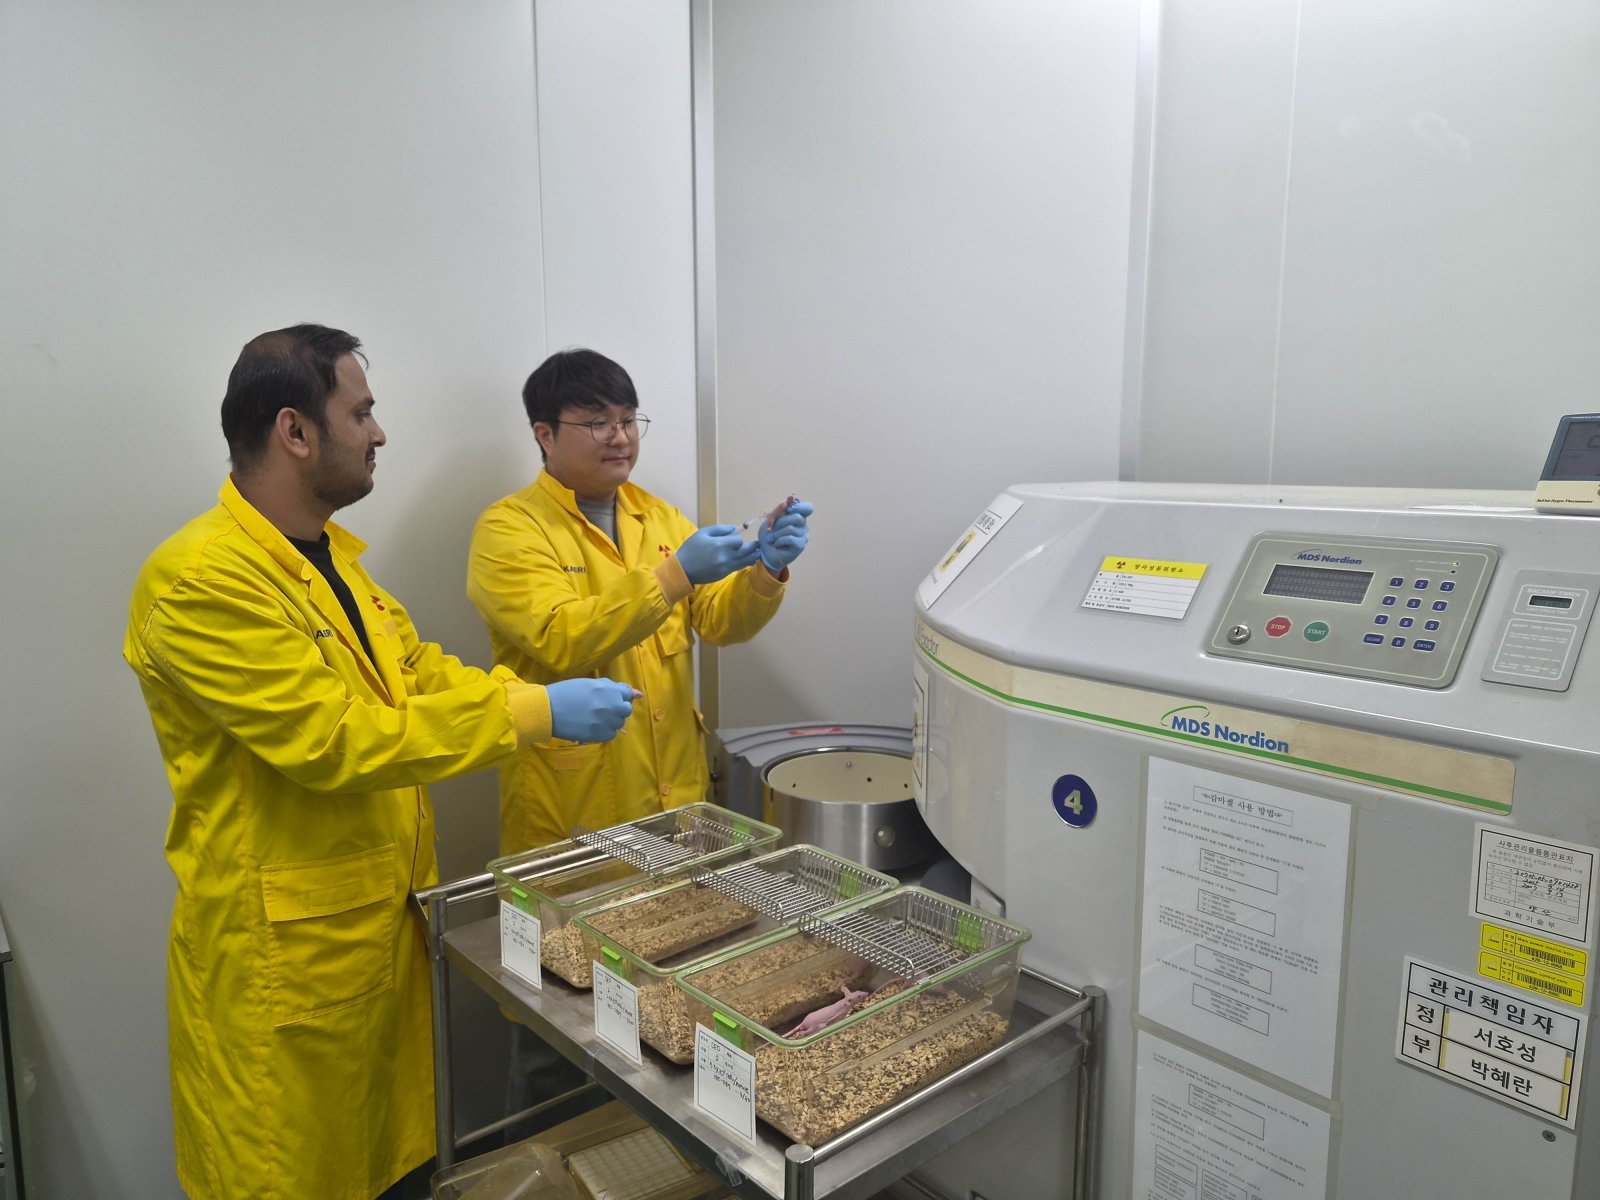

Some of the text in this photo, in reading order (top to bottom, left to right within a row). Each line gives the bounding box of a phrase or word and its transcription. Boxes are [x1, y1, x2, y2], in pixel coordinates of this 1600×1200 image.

[1297, 553, 1362, 565] MDS Nordion
[1172, 716, 1289, 753] MDS Nordion
[1064, 790, 1083, 815] 4
[1238, 802, 1254, 812] 사용
[1258, 807, 1274, 818] 방법
[1429, 978, 1554, 1035] 관리책임자
[1416, 1004, 1536, 1062] 정 서호성
[1412, 1035, 1533, 1097] 부 박혜란
